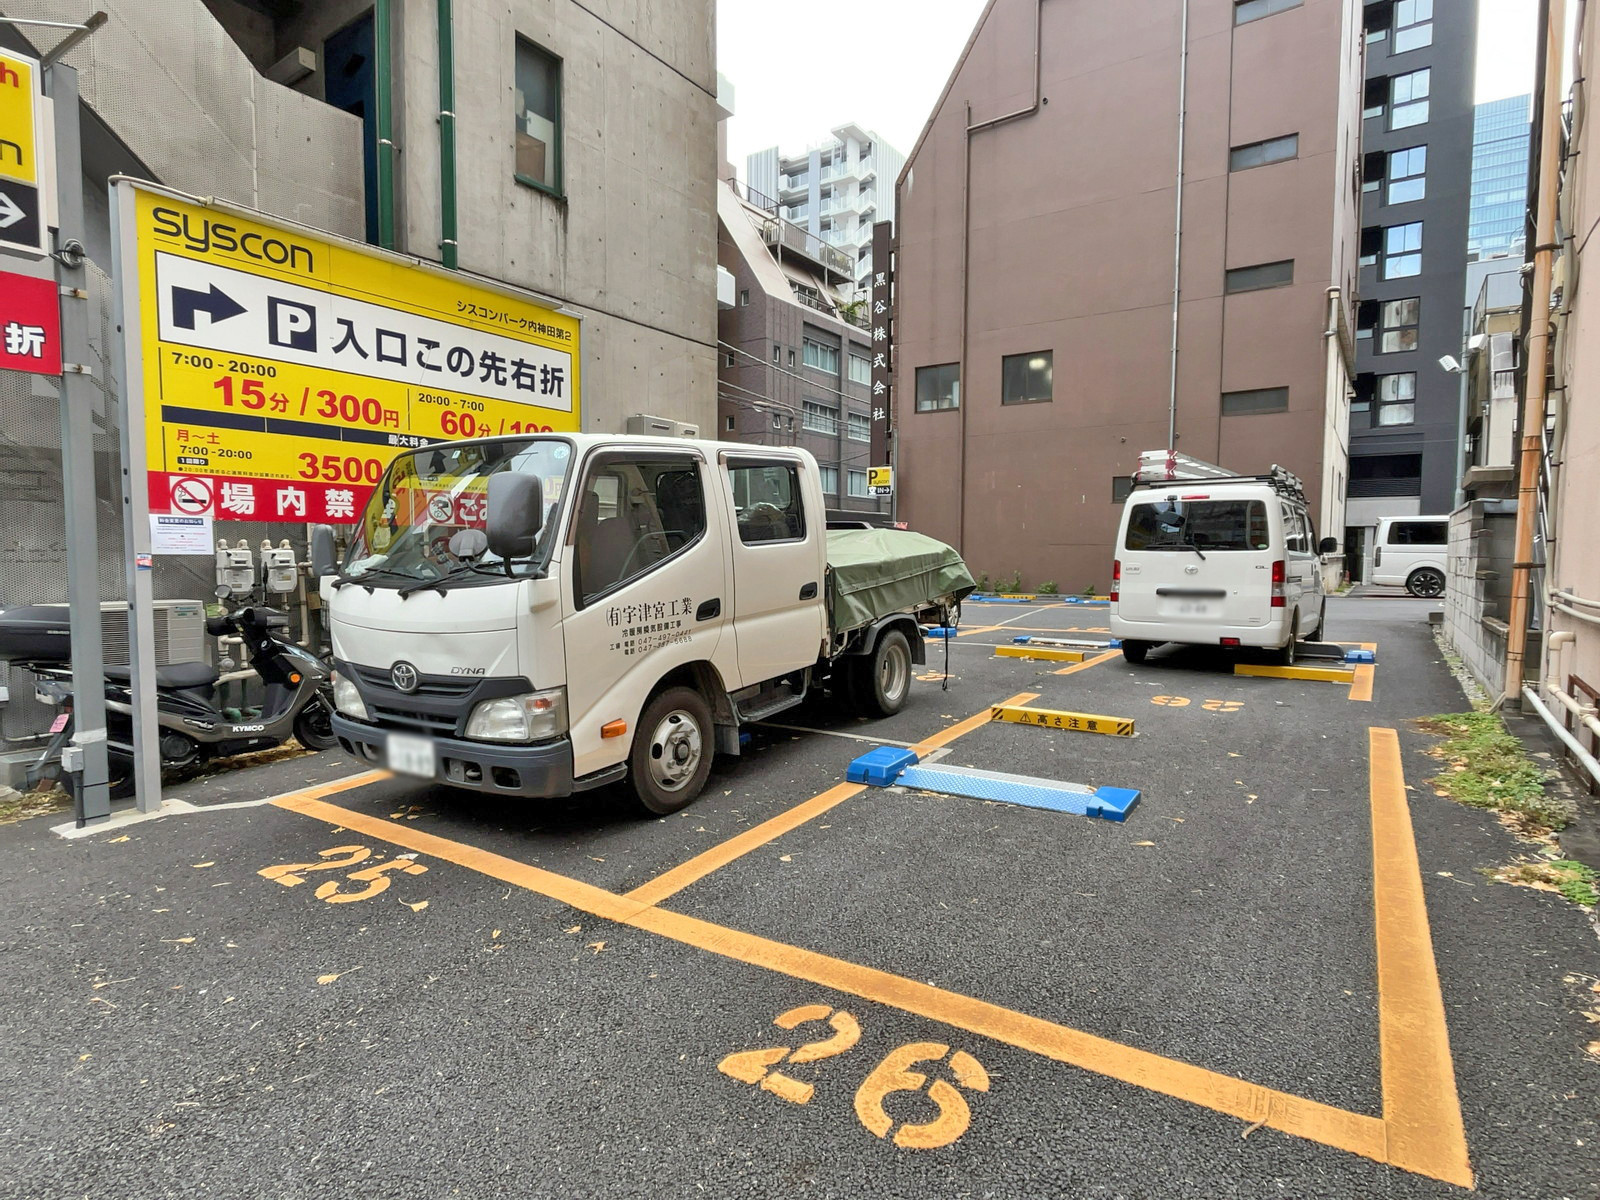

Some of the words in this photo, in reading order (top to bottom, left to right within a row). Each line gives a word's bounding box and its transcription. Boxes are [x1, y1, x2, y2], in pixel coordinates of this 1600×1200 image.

[153, 207, 313, 273] syscon
[332, 317, 565, 398] 入口この先右折
[873, 272, 887, 421] 黒谷株式会社
[868, 470, 878, 485] P
[450, 666, 485, 675] DYNA
[232, 724, 265, 732] KYMCO
[1037, 714, 1098, 731] 高さ注意
[257, 845, 430, 904] 25
[717, 1004, 990, 1149] 26
